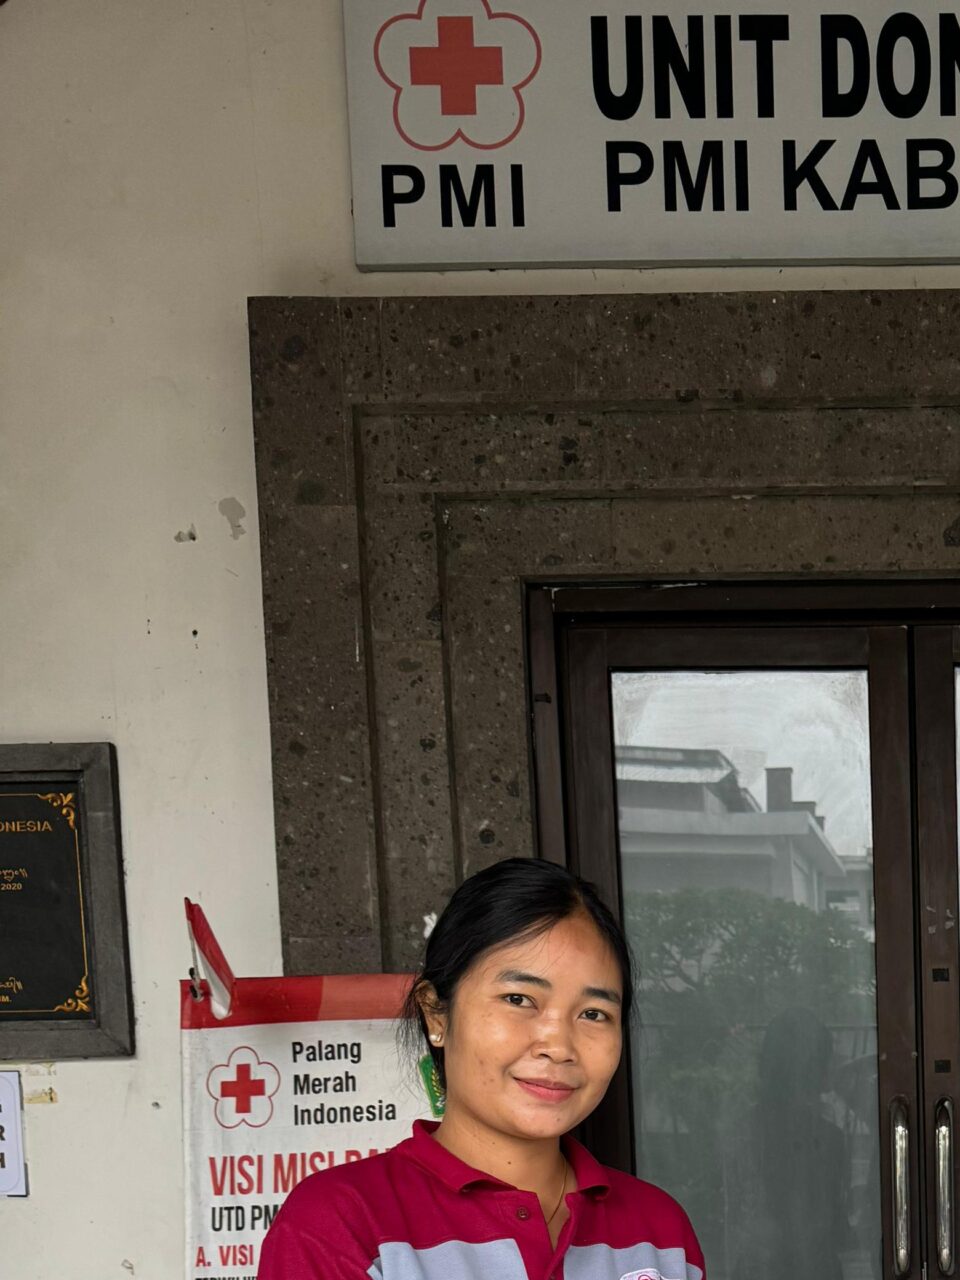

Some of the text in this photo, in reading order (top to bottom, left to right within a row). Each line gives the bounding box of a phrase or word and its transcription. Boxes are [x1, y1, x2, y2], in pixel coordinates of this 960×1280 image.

[590, 14, 789, 120] UNIT
[605, 140, 749, 212] PMI
[381, 164, 525, 228] PMI
[1, 882, 23, 891] 2020
[292, 1040, 362, 1064] Palang
[293, 1071, 356, 1095] Merah
[294, 1099, 396, 1126] Indonesia
[208, 1154, 263, 1196] VISI
[211, 1204, 282, 1232] UTD PM
[195, 1244, 254, 1267] A. VISI
